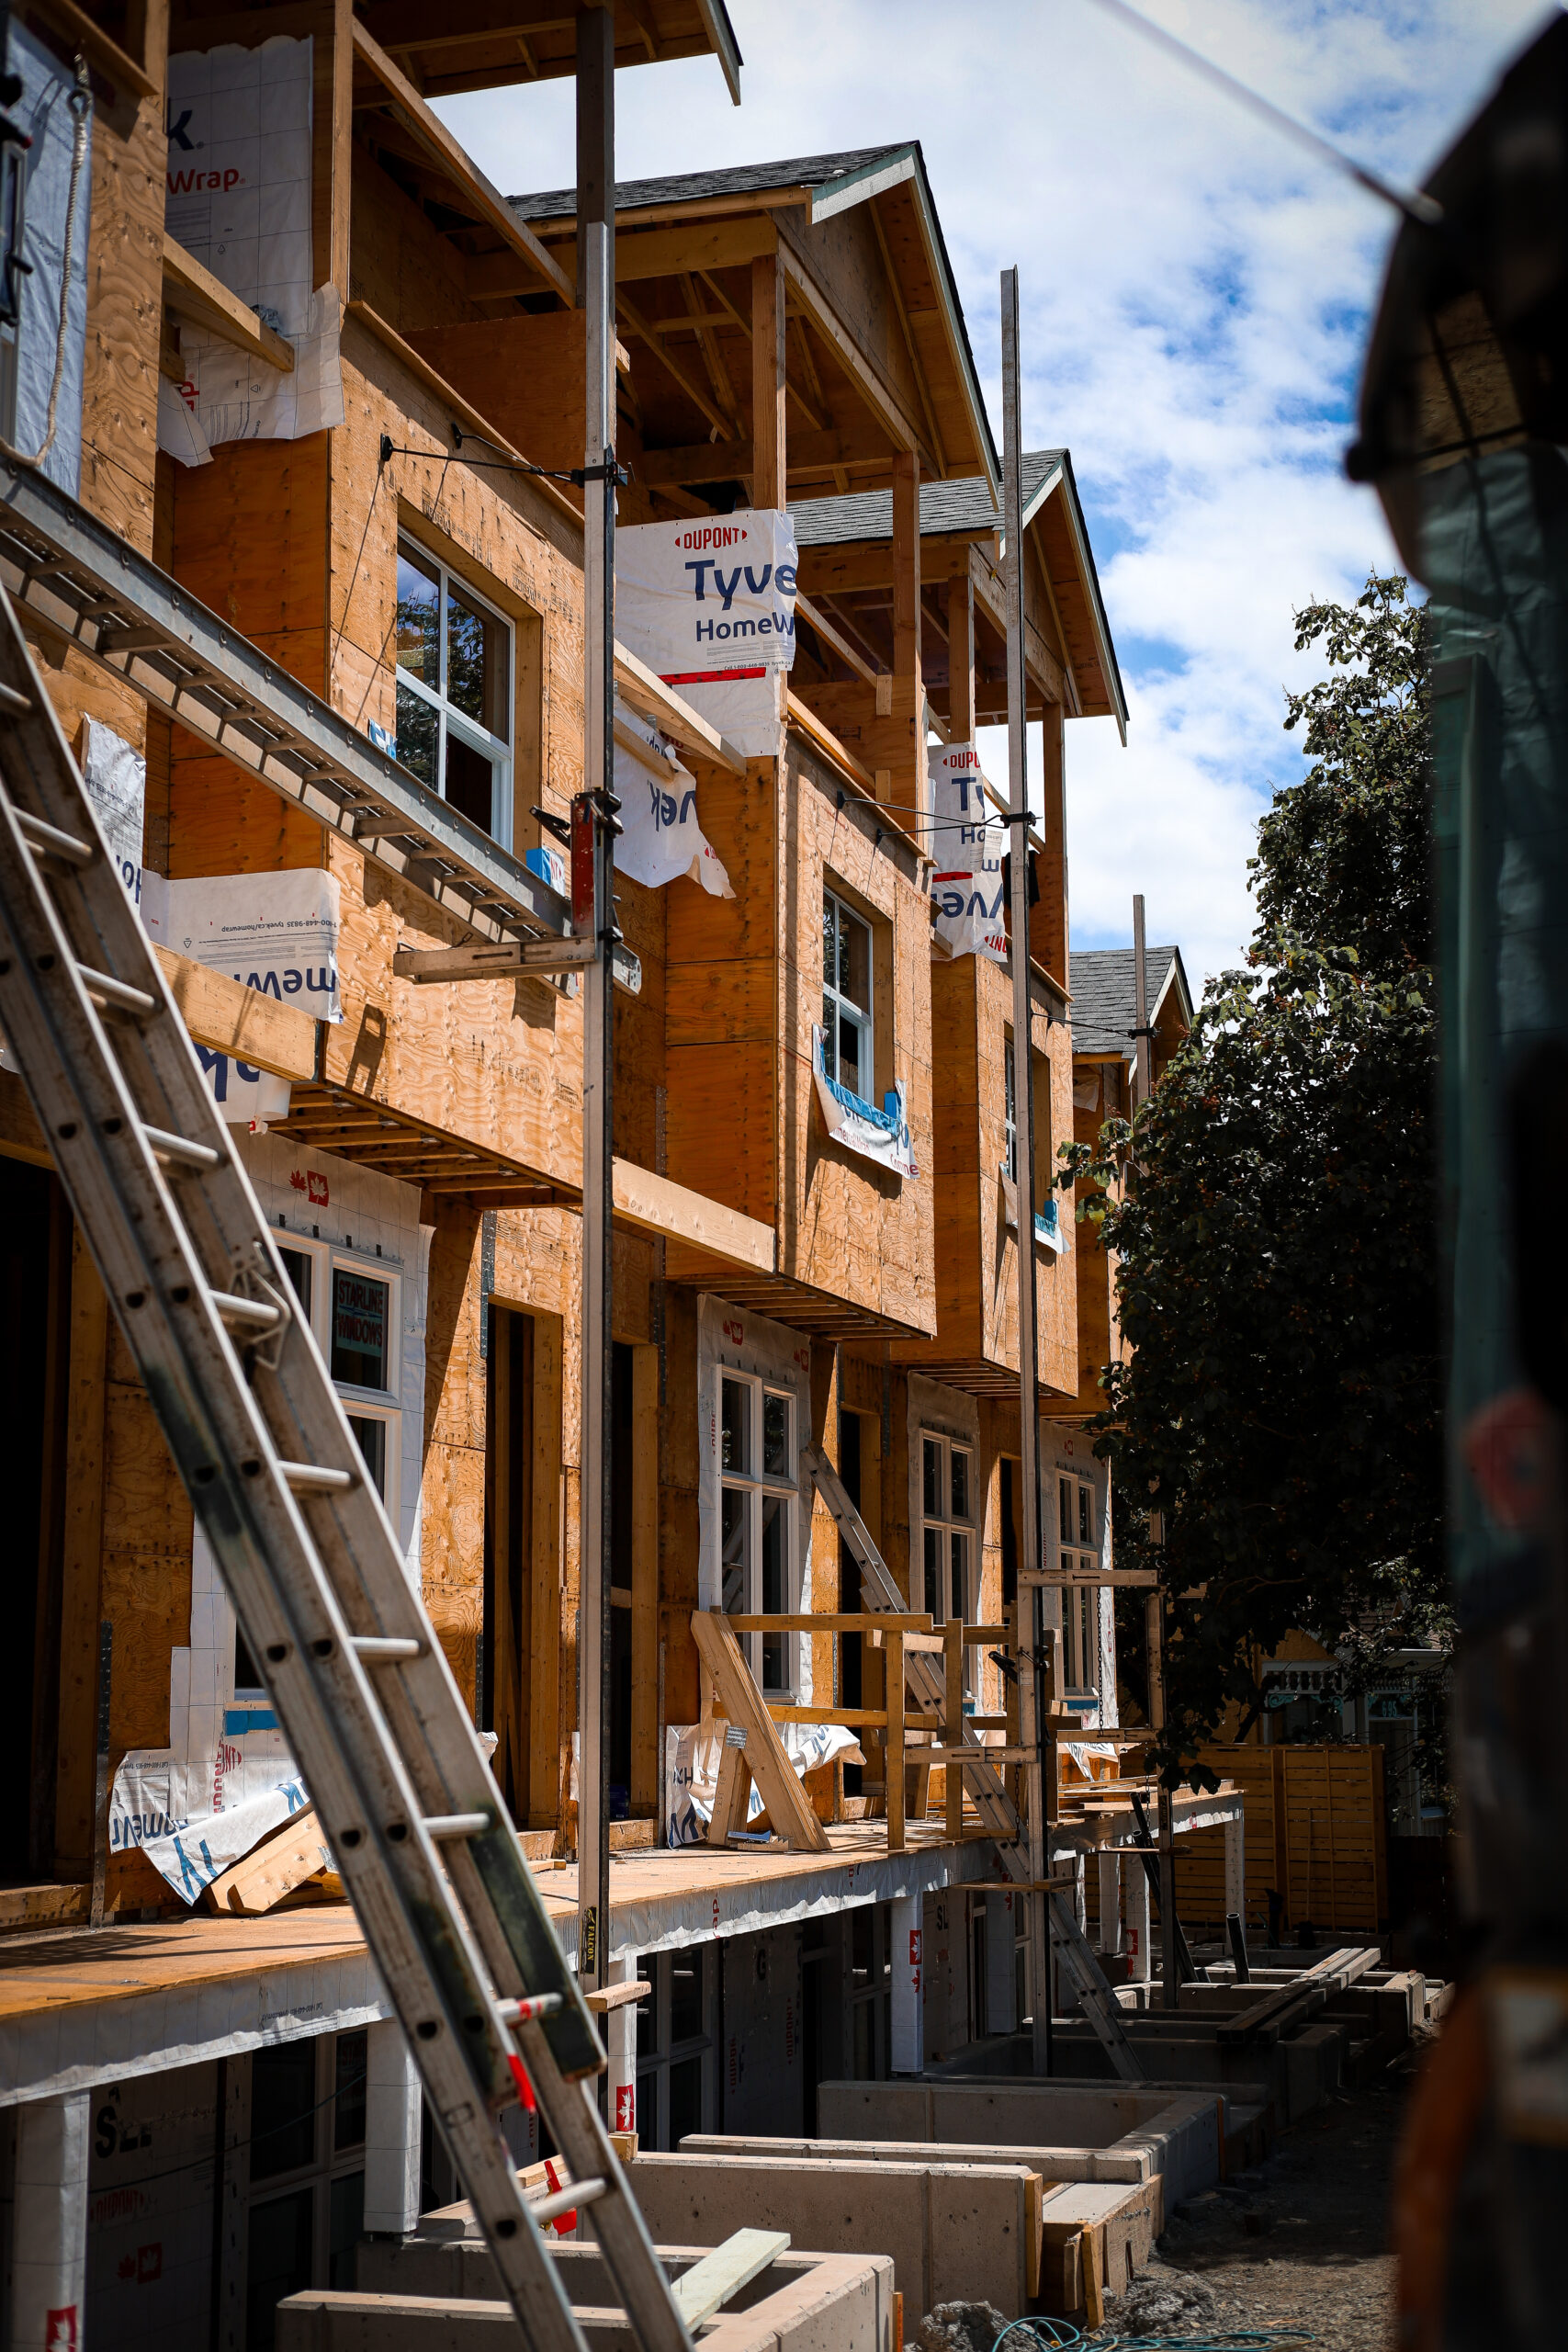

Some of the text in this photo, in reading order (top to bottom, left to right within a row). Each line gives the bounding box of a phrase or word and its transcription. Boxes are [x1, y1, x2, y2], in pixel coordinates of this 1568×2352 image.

[166, 168, 240, 196] Wrap
[683, 526, 740, 550] DUPONT
[685, 560, 797, 611] Tyve
[696, 612, 795, 642] HomeW
[221, 922, 285, 933] tyvek.ca/homewrap
[338, 1278, 384, 1315] STARLINE
[337, 1312, 384, 1348] WINDOWS
[1382, 1700, 1397, 1718] 695
[587, 1925, 595, 1961] FALCON
